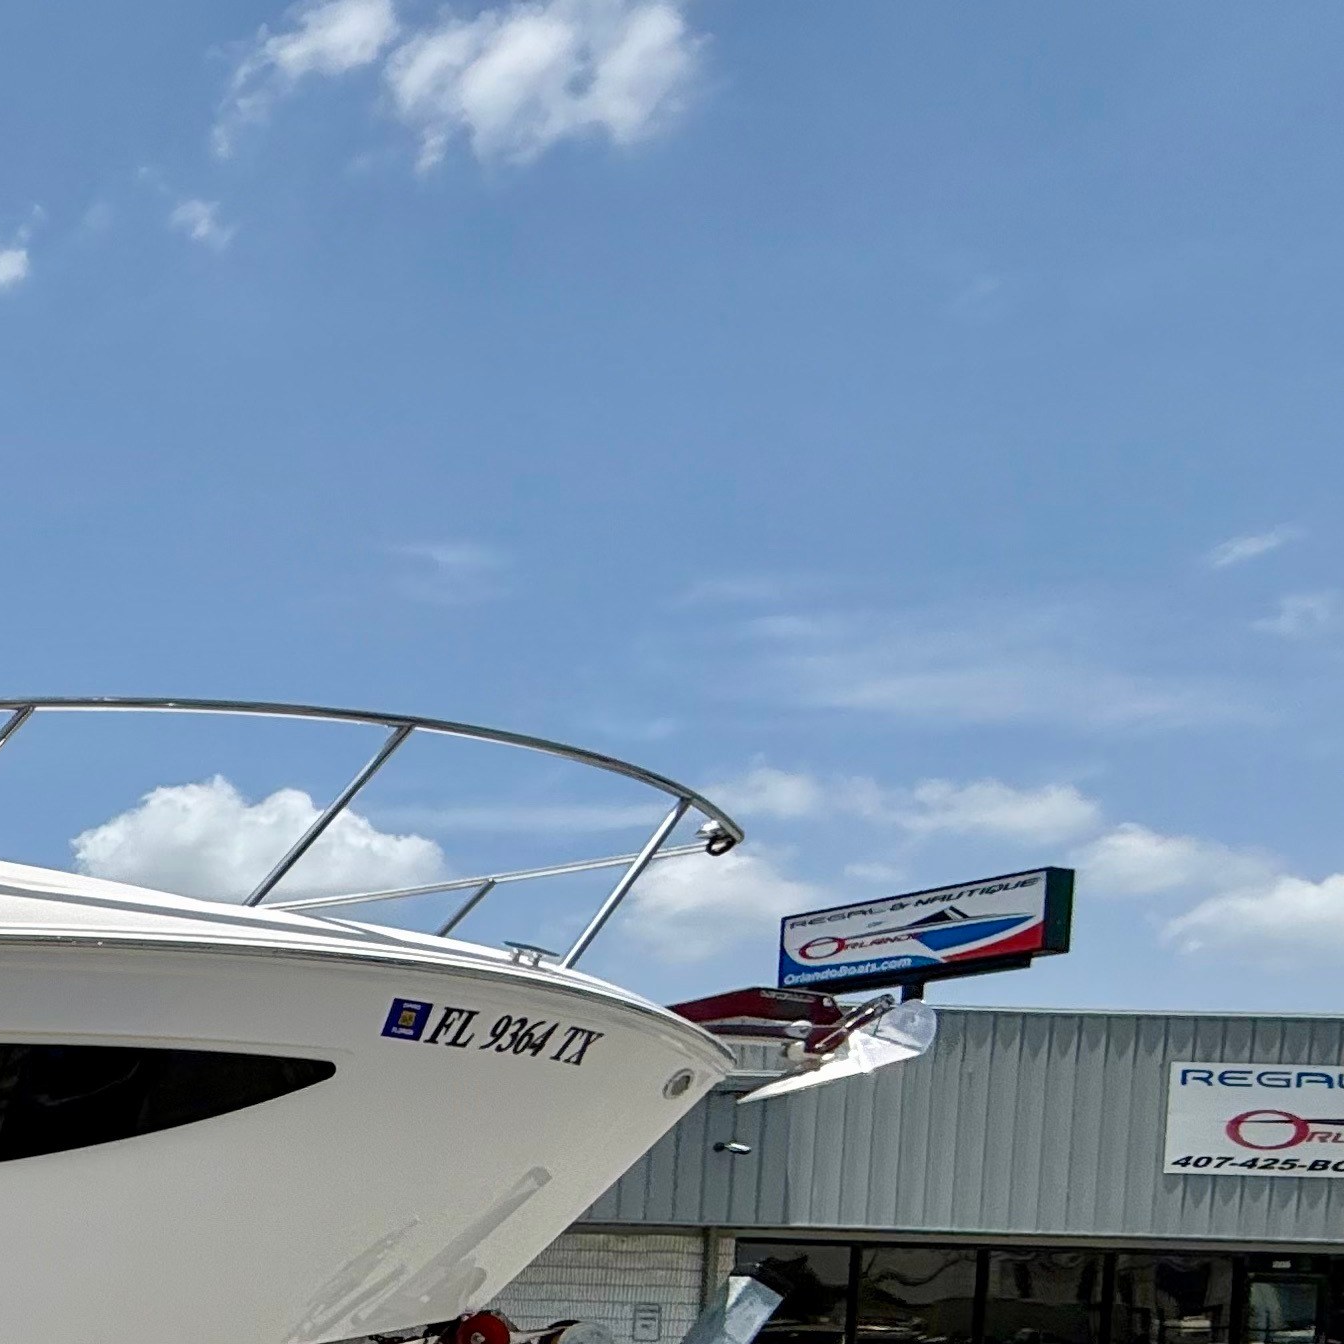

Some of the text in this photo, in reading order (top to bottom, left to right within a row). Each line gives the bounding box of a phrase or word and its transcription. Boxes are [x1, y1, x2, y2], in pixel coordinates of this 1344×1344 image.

[789, 906, 884, 930] REGAL
[913, 876, 1042, 908] NAUTIQUE
[783, 957, 912, 985] OrlandoBoats.com
[423, 1006, 605, 1066] FL 9364 TX
[1180, 1069, 1344, 1089] REGA
